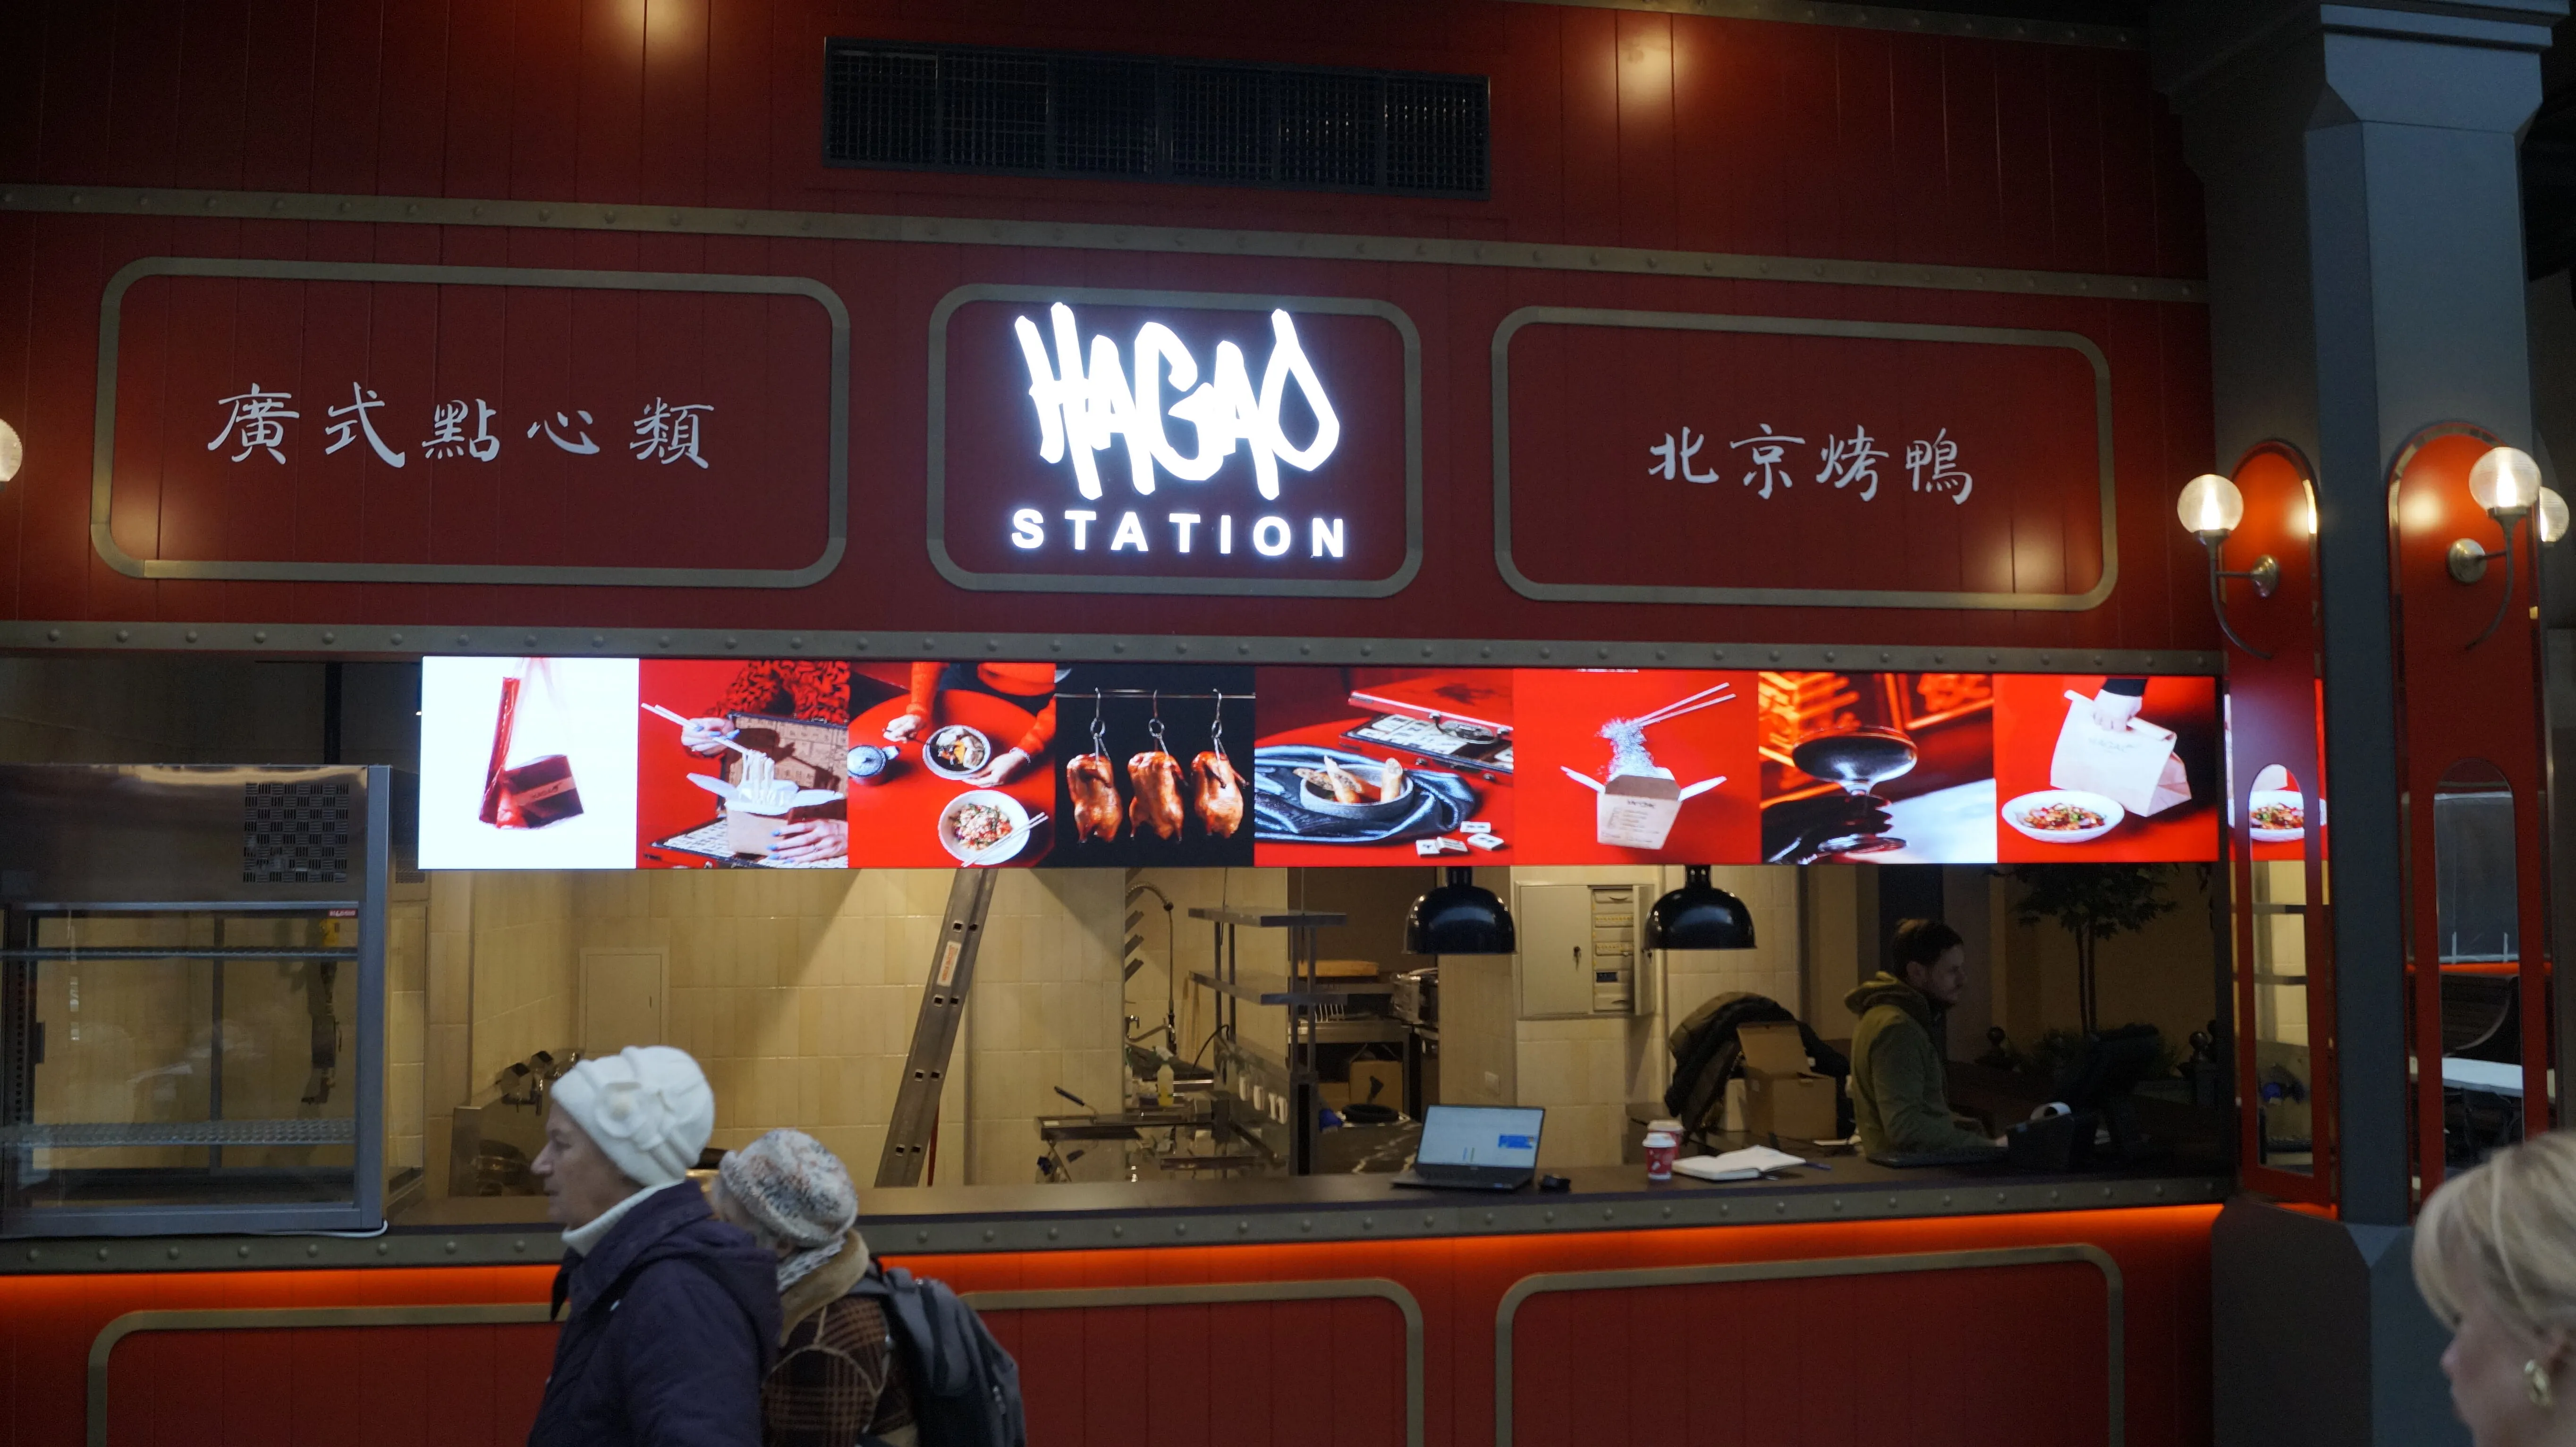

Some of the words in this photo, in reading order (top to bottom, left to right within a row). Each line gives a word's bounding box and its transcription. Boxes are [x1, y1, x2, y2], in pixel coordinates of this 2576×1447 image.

[207, 382, 714, 469] 廣式點心類
[1014, 302, 1340, 501] HAGAO
[1648, 423, 1973, 505] 北京烤鴨
[1011, 508, 1343, 557] STATION
